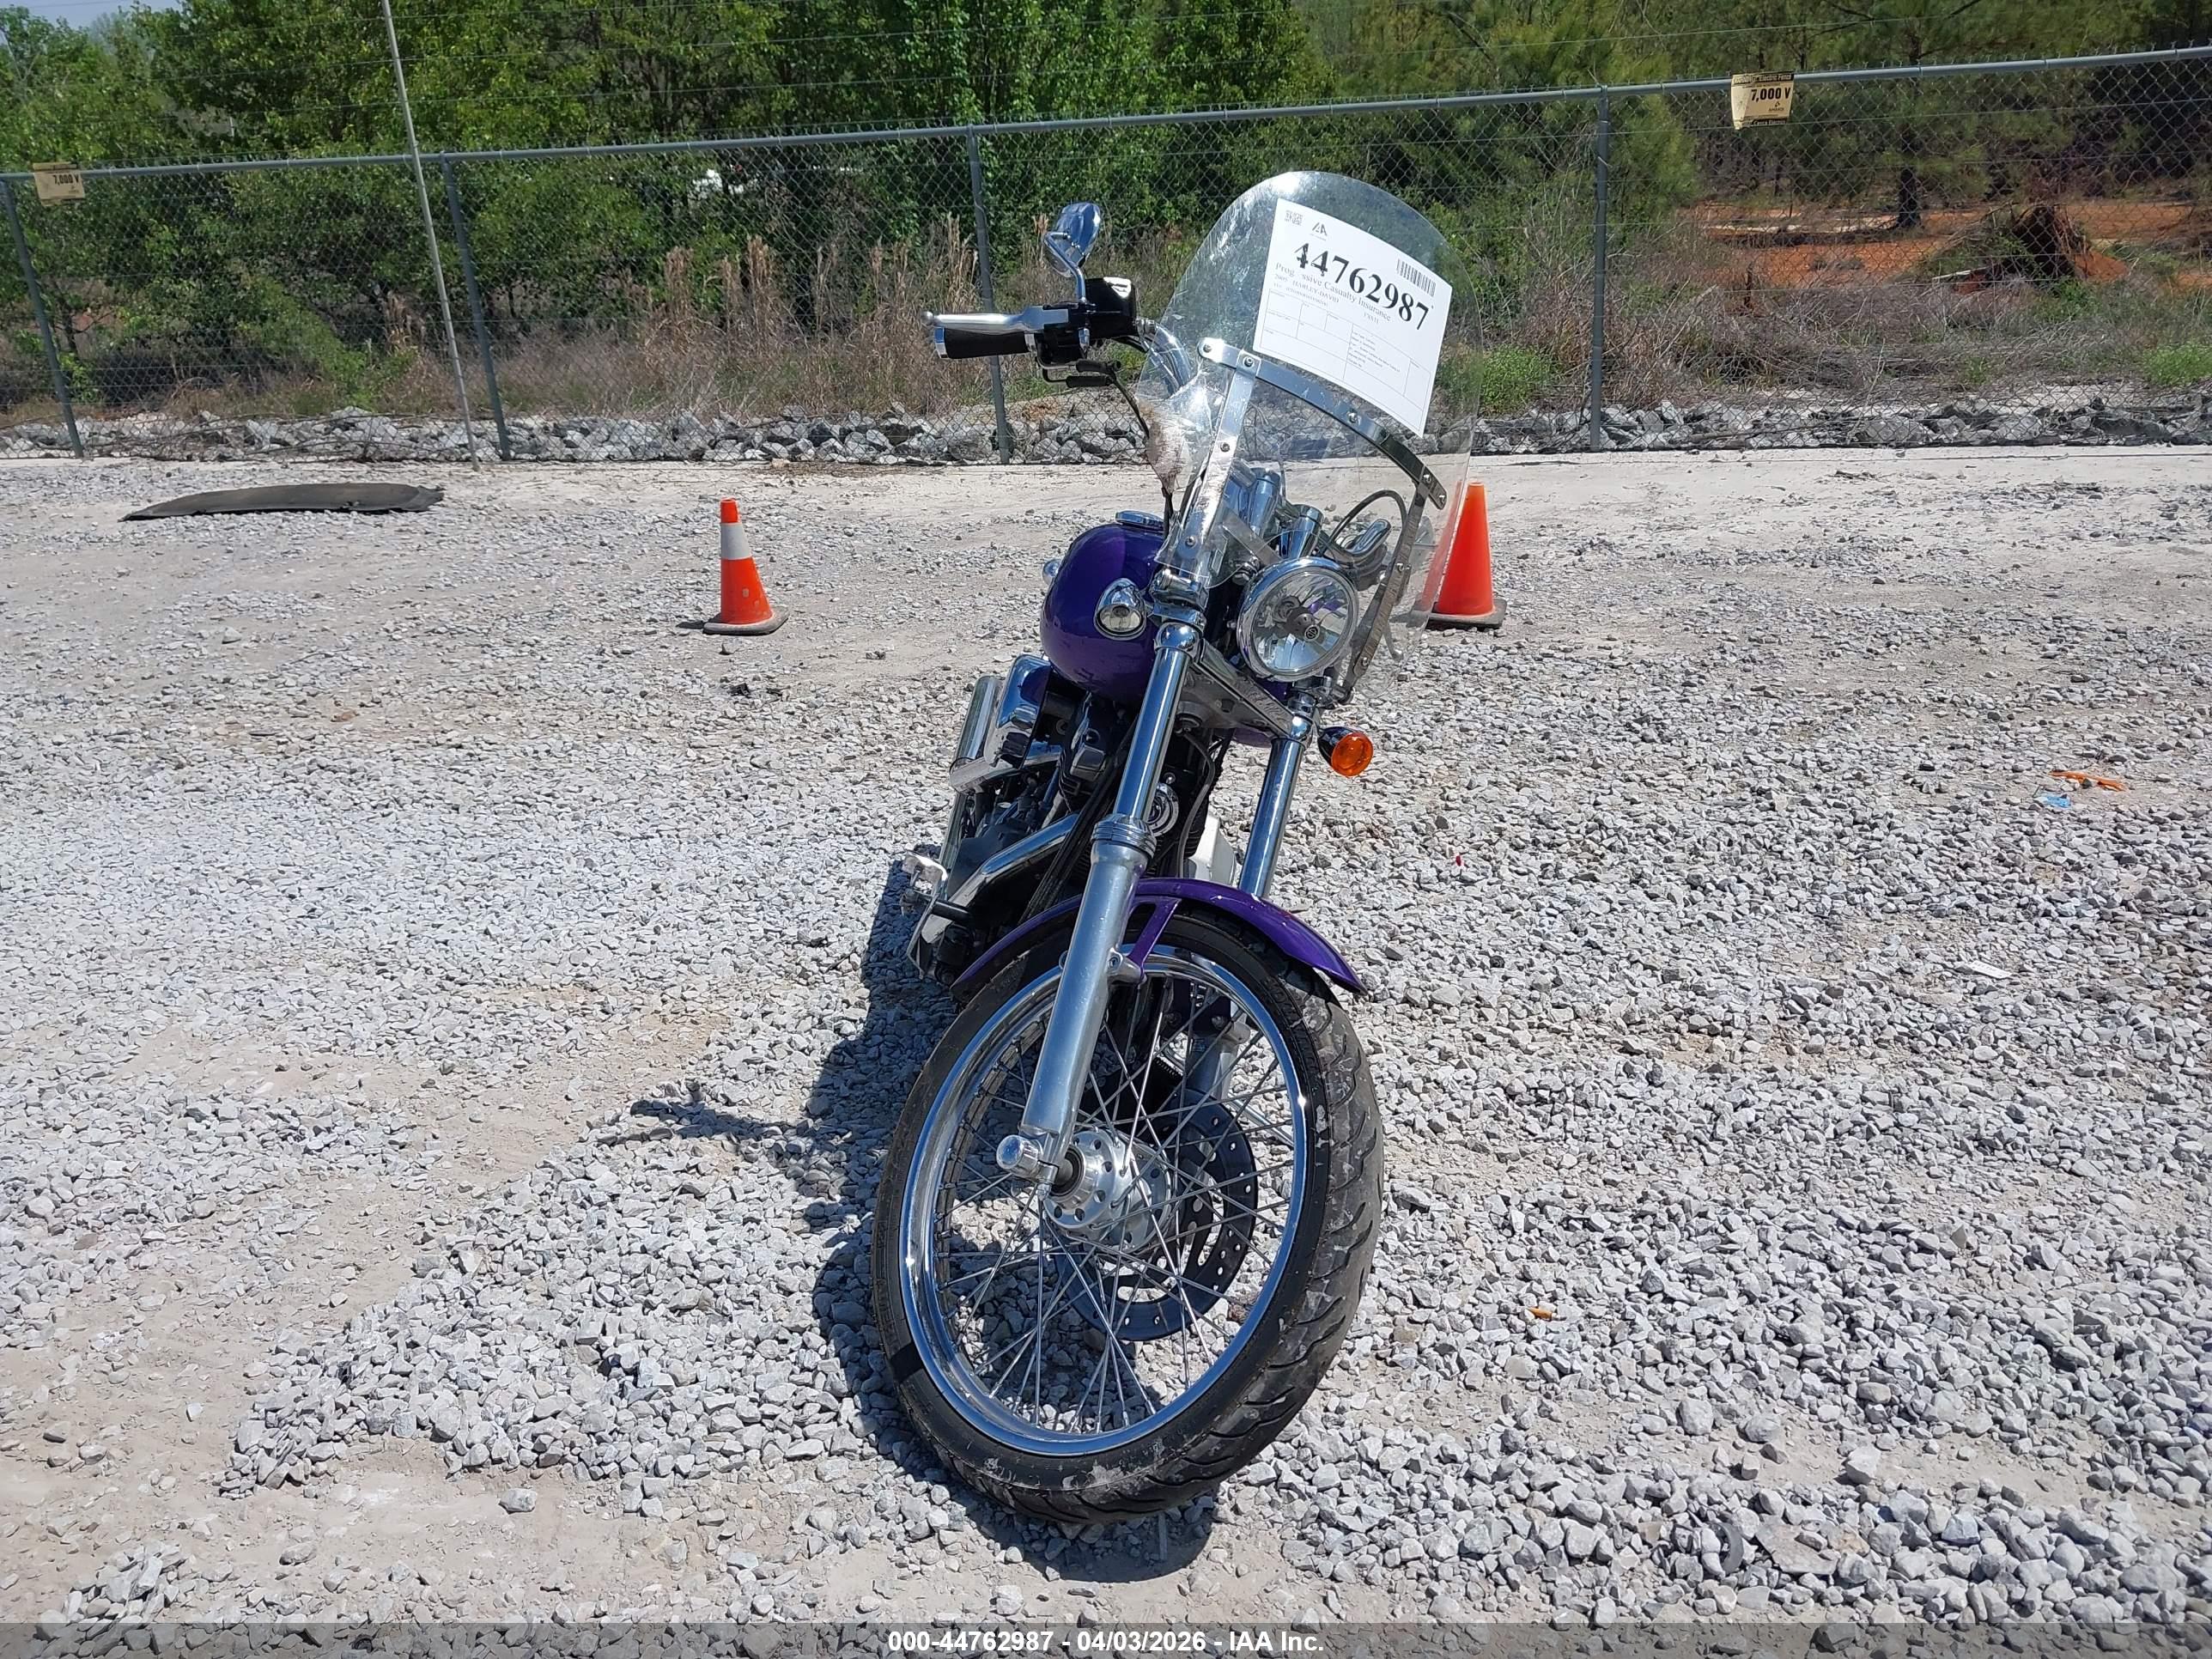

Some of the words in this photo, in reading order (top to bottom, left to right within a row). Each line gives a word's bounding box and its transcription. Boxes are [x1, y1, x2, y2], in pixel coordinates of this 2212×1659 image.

[1751, 88, 1782, 102] 7,000
[1784, 87, 1791, 99] V
[52, 174, 73, 185] 7,000
[74, 174, 79, 183] V
[1294, 242, 1429, 331] 44762987
[1324, 281, 1356, 303] Casualty
[1358, 296, 1391, 321] Insurance
